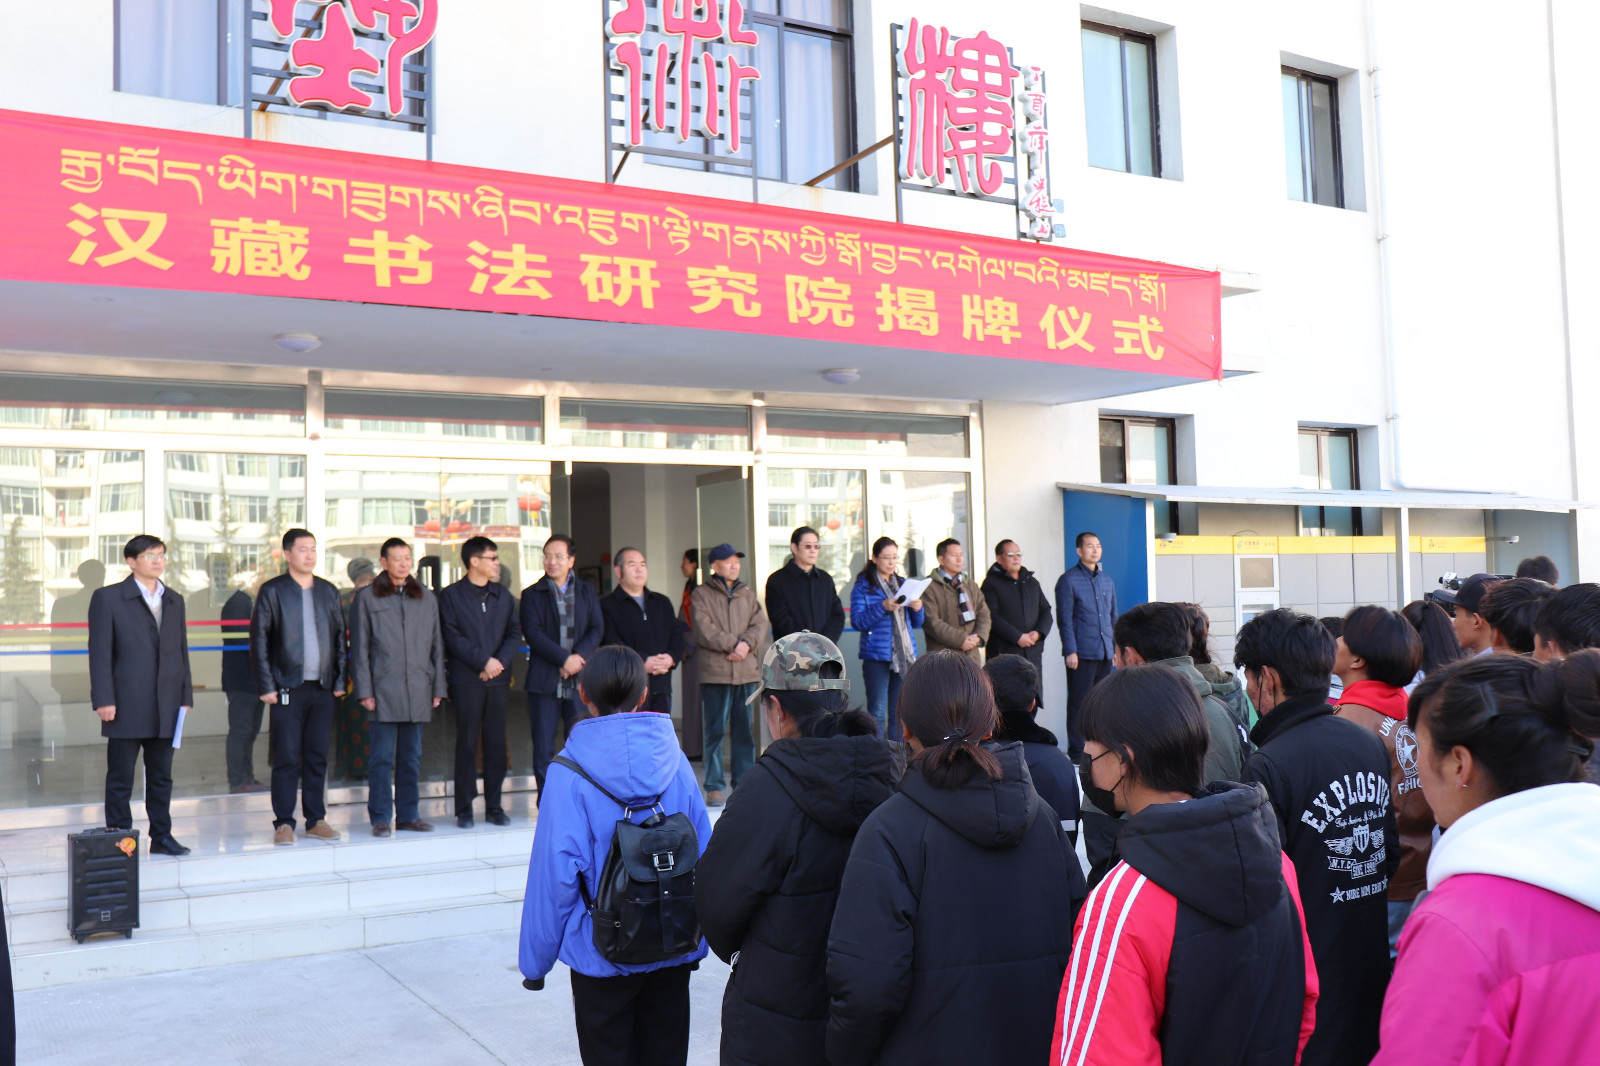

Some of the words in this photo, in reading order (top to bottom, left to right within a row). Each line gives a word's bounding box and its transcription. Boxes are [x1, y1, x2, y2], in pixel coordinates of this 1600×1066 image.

[66, 203, 1165, 361] 汉藏书法研究院揭牌仪式
